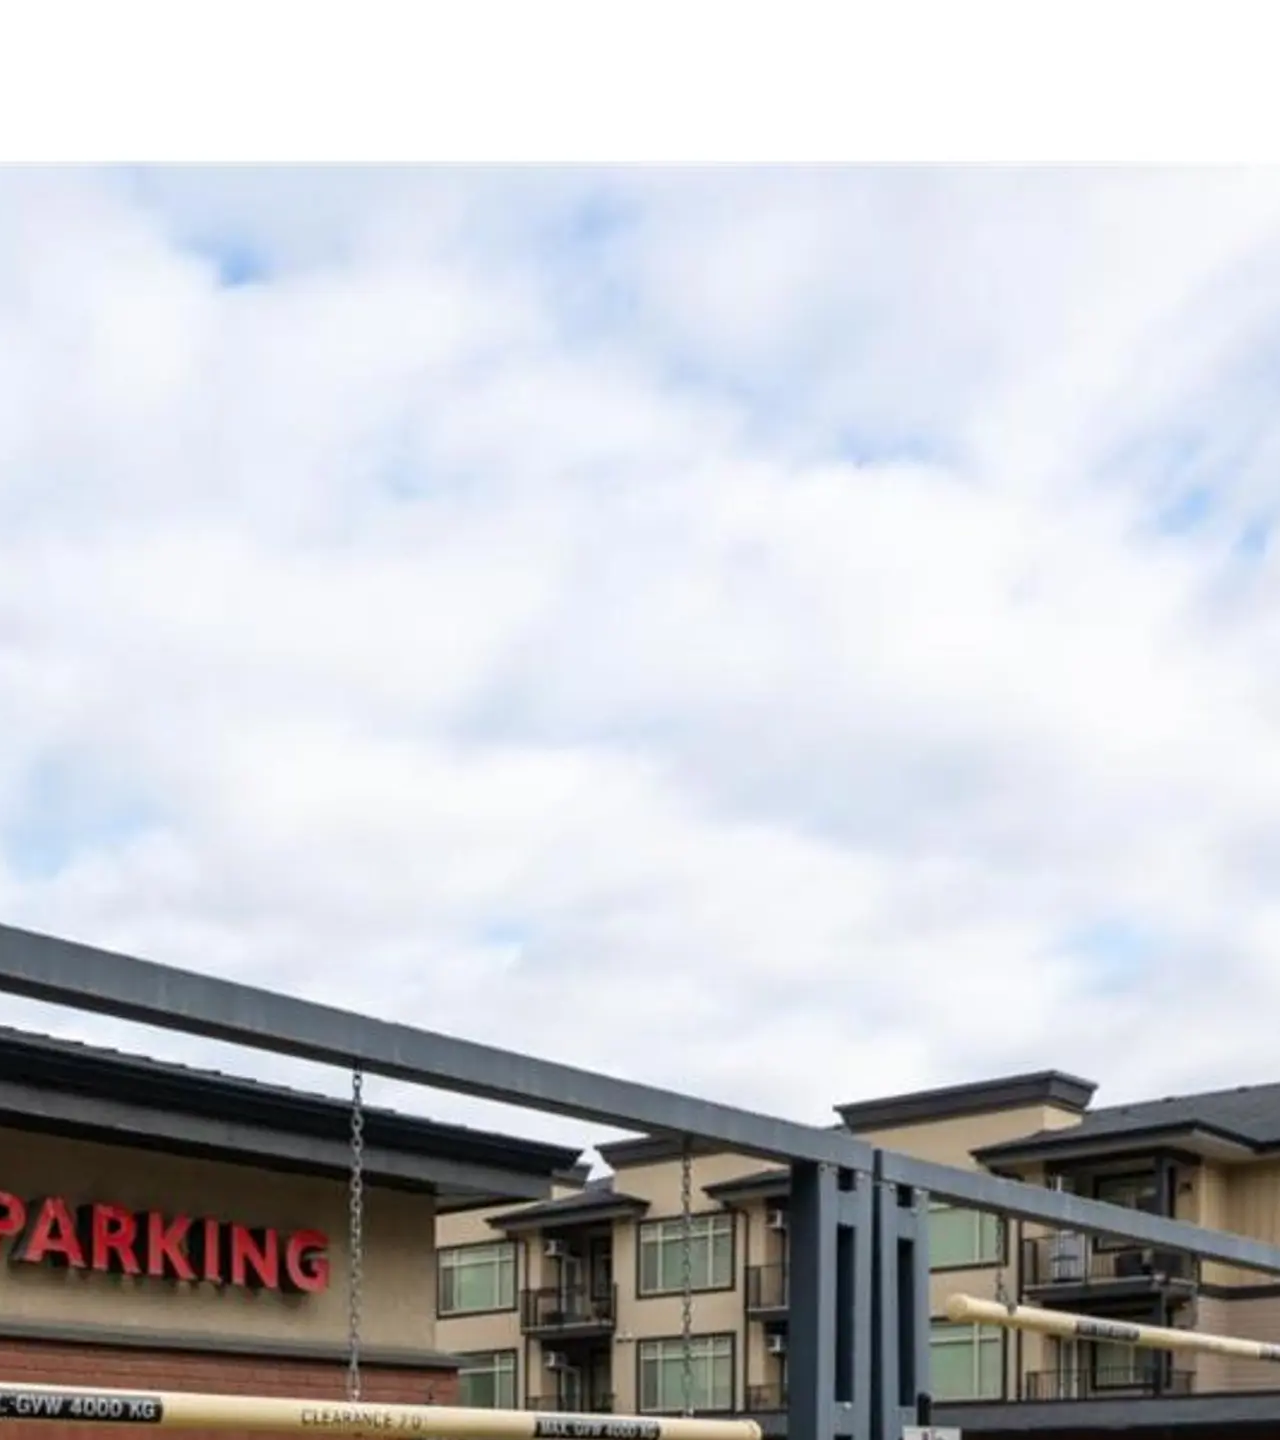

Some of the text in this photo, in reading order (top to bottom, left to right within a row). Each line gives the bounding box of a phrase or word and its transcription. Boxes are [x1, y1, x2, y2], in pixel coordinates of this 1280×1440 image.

[16, 1393, 65, 1415] GVW
[70, 1396, 122, 1418] 4000
[128, 1399, 156, 1420] KG
[301, 1408, 392, 1429] CLEARANCE
